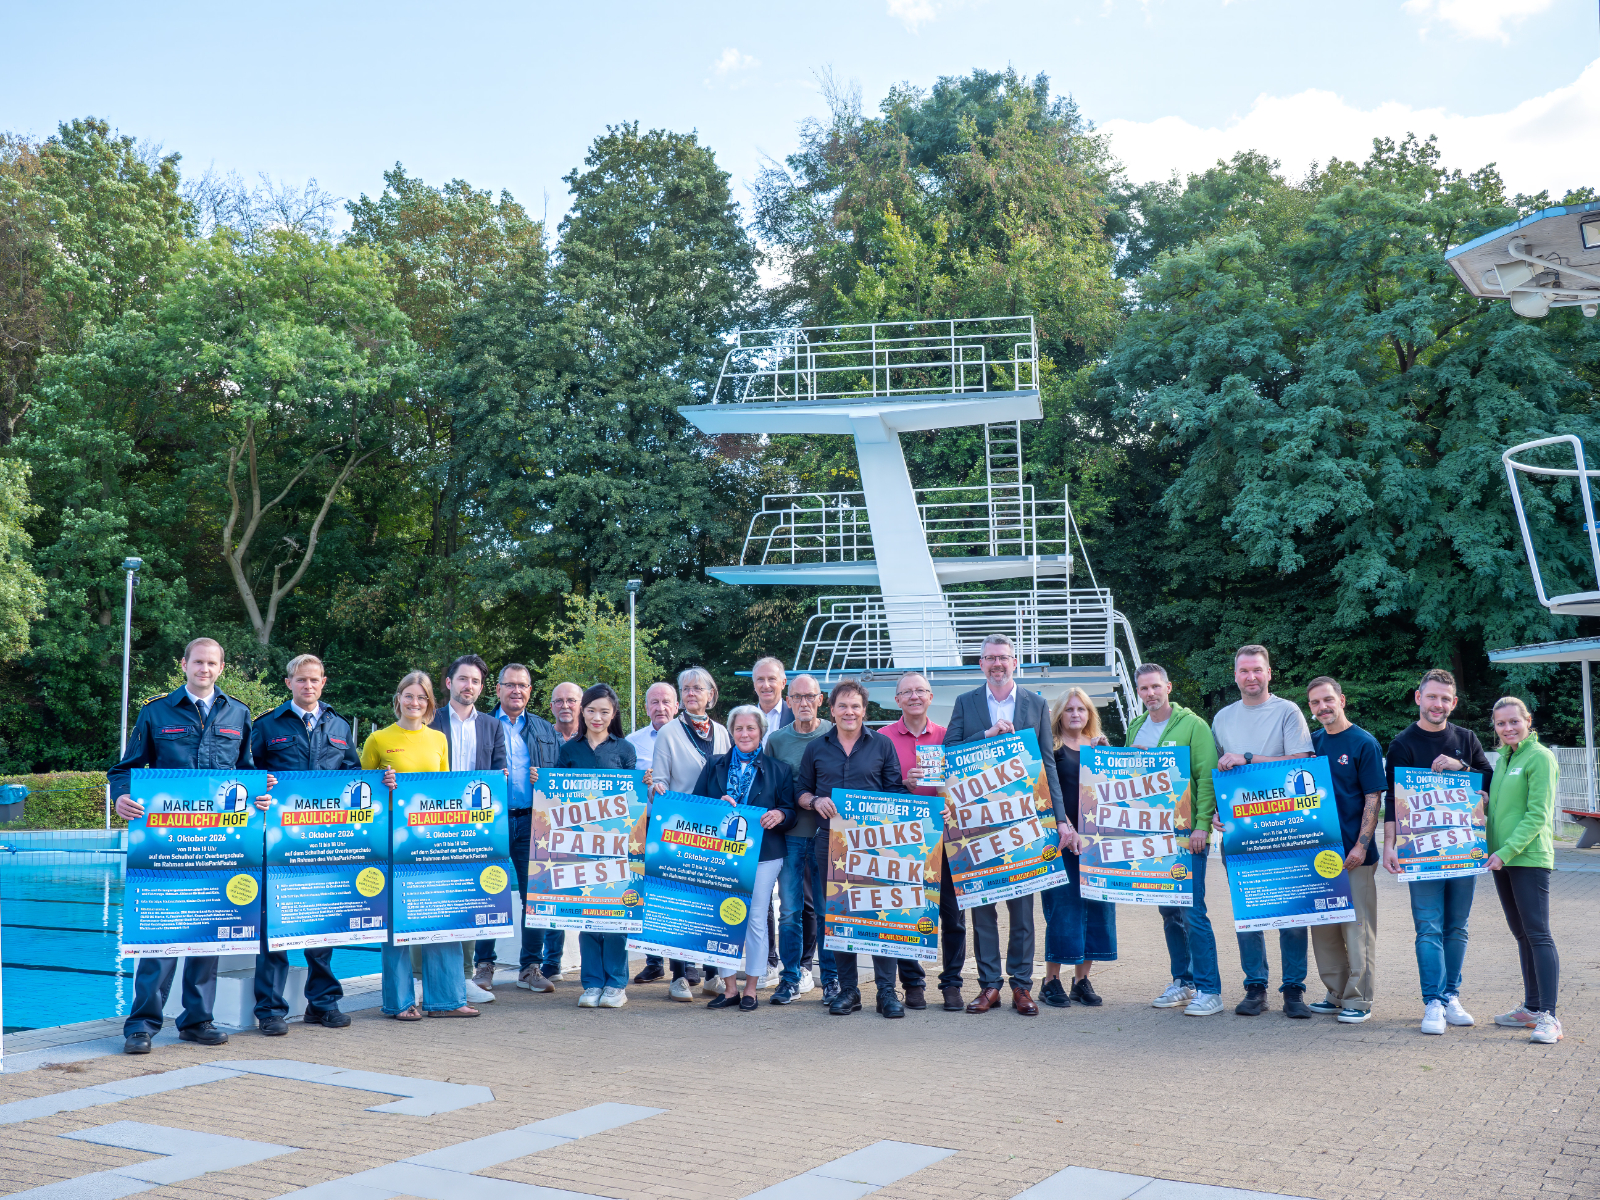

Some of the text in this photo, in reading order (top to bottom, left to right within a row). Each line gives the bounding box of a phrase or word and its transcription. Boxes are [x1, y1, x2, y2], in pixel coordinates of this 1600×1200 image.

[955, 745, 1006, 767] OKTOBER
[1094, 756, 1104, 766] 3.
[1107, 757, 1156, 768] OKTOBER
[549, 779, 559, 790] 3.
[562, 779, 614, 791] OKTOBER
[951, 759, 1024, 804] VOLKS
[1097, 772, 1170, 802] VOLKS
[1406, 776, 1414, 784] 3.
[1416, 776, 1455, 786] OKTOBER
[295, 798, 341, 810] MARLER
[1242, 787, 1286, 803] MARLER
[1409, 788, 1466, 809] VOLKS
[163, 800, 214, 811] MARLER
[420, 799, 463, 811] MARLER
[551, 796, 626, 827] VOLKS
[845, 800, 855, 812] 3.
[858, 801, 910, 817] OKTOBER
[959, 796, 1034, 828] PARK
[1234, 796, 1319, 817] BLAULICHT HOF
[150, 814, 246, 826] BLAULICHT HOF
[284, 811, 372, 825] BLAULICHT HOF
[410, 811, 492, 825] BLAULICHT HOF
[1099, 807, 1171, 830] PARK
[1260, 818, 1287, 828] Oktober
[1287, 816, 1305, 825] 2026
[1412, 813, 1469, 827] PARK
[309, 831, 336, 839] Oktober
[338, 830, 354, 838] 2026
[433, 830, 460, 838] Oktober
[676, 819, 718, 837] MARLER
[848, 822, 922, 849] VOLKS
[177, 834, 208, 842] Oktober
[209, 834, 227, 842] 2026
[551, 832, 626, 855] PARK
[664, 830, 745, 855] BLAULICHT HOF
[969, 817, 1040, 863] FEST
[1415, 828, 1471, 852] FEST
[1102, 834, 1174, 861] FEST
[676, 850, 726, 866] 3. Oktober 2026
[553, 859, 627, 887] FEST
[848, 854, 922, 882] PARK
[850, 887, 923, 909] FEST
